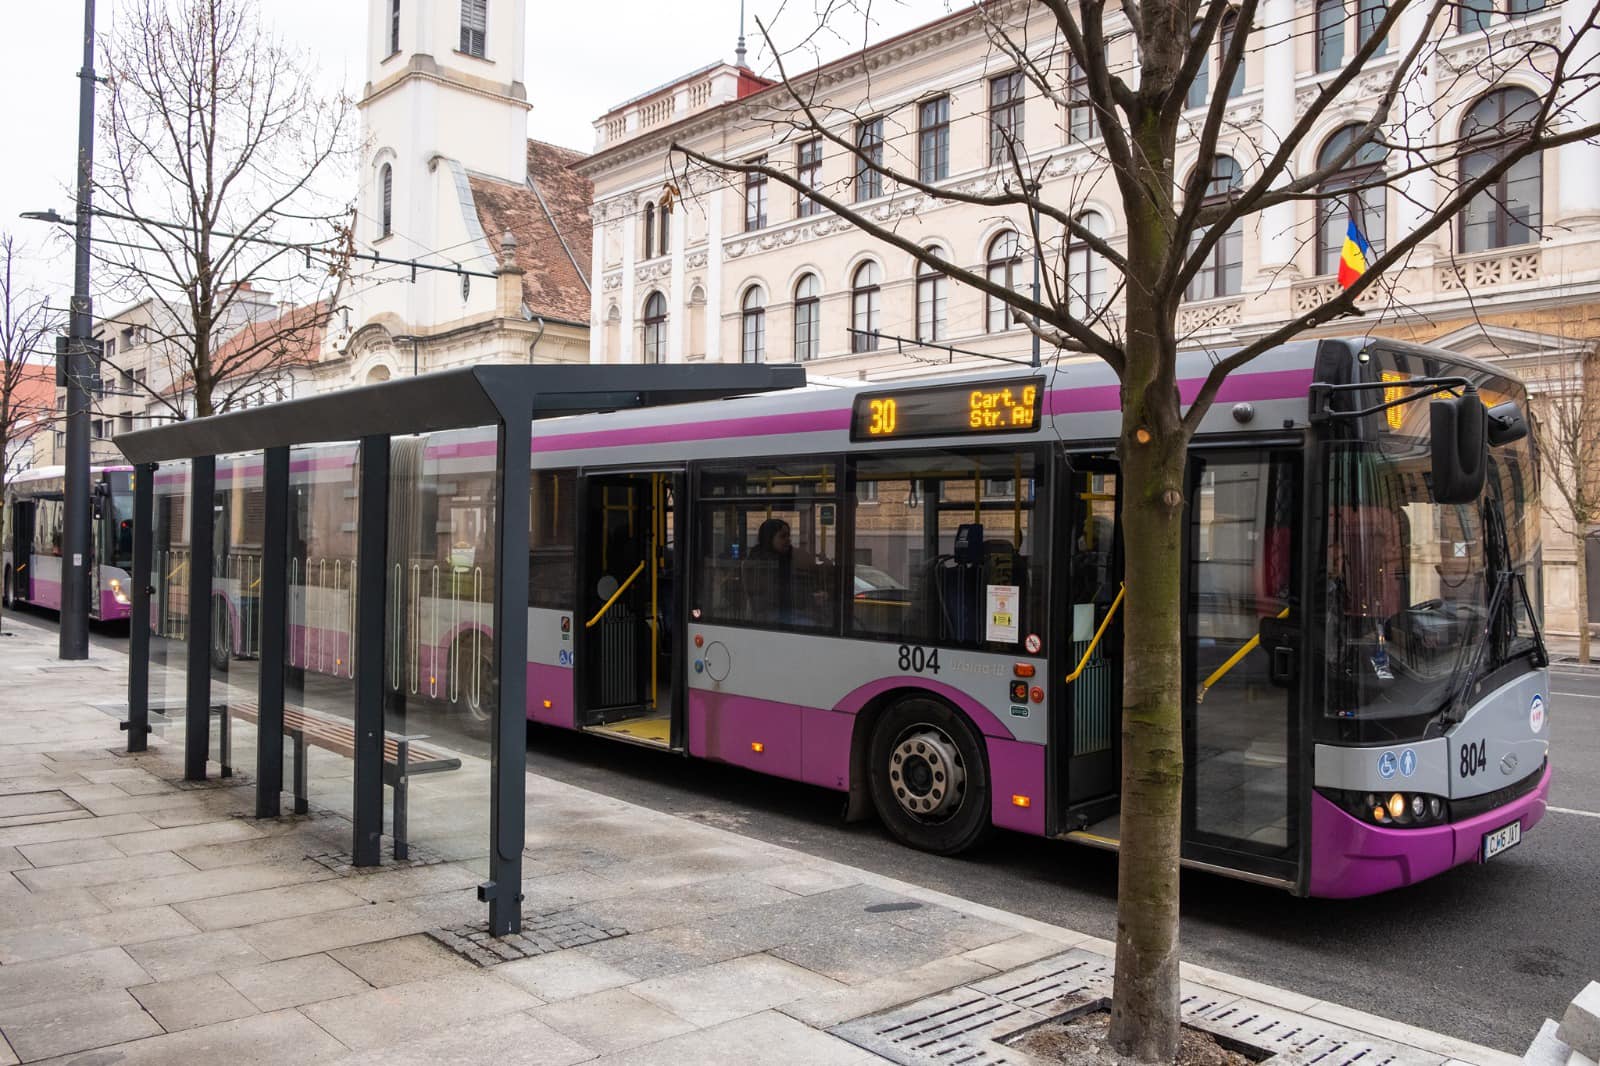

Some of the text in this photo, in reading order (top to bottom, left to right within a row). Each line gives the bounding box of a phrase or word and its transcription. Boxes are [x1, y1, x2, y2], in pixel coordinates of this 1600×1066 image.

[969, 388, 1017, 410] Cart.
[868, 398, 897, 435] 30
[969, 409, 1006, 428] Str.
[898, 644, 940, 674] 804
[1459, 738, 1487, 778] 804
